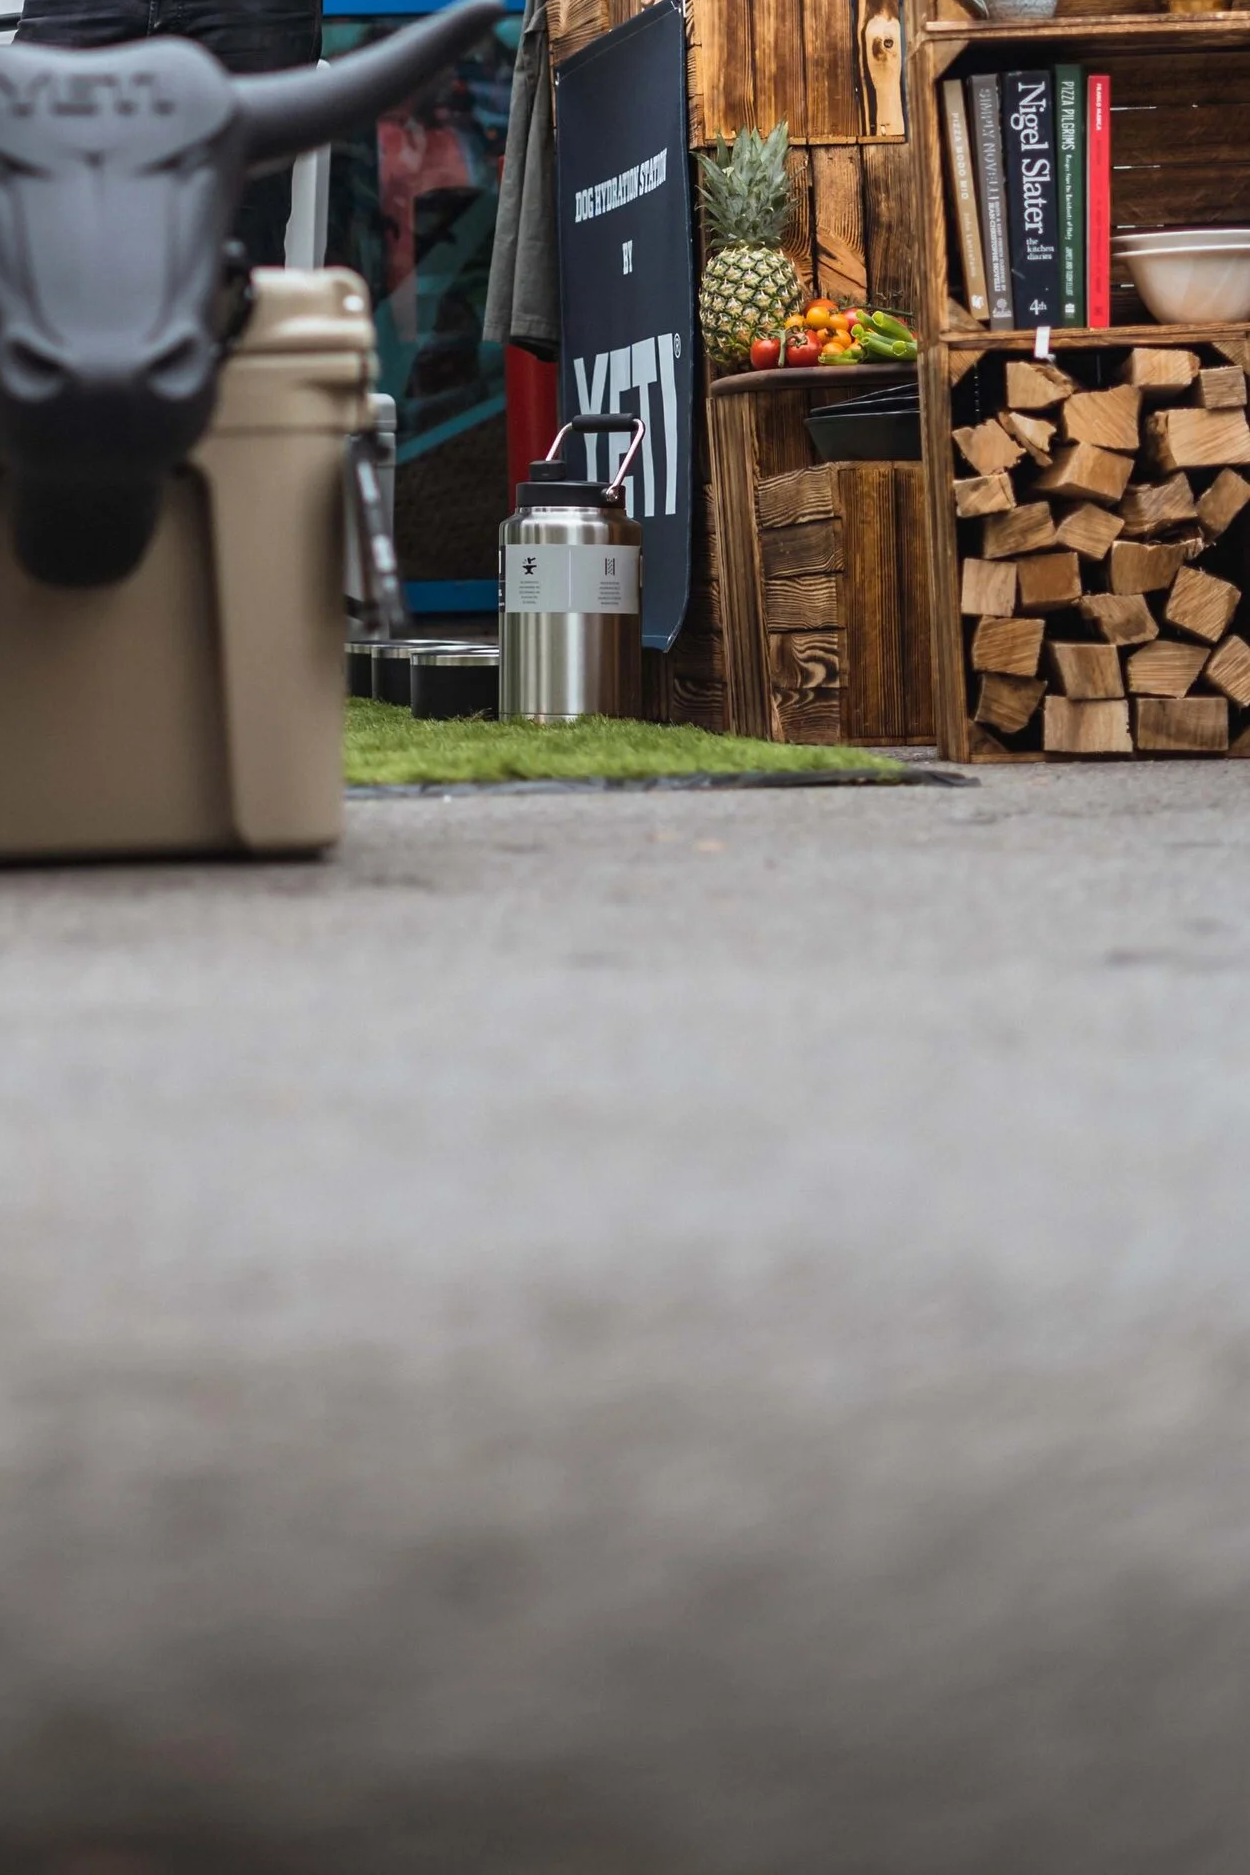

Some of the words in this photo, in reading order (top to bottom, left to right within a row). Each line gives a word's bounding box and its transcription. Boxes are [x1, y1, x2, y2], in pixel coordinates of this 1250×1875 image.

[1010, 80, 1049, 152] Nigel
[1061, 81, 1075, 106] PIZZA
[1061, 108, 1076, 151] PILGRIMS
[575, 187, 594, 223] DOG
[594, 165, 640, 217] HYDRATION
[639, 147, 668, 196] STATION
[1021, 158, 1051, 234] Slater
[622, 239, 633, 275] BY
